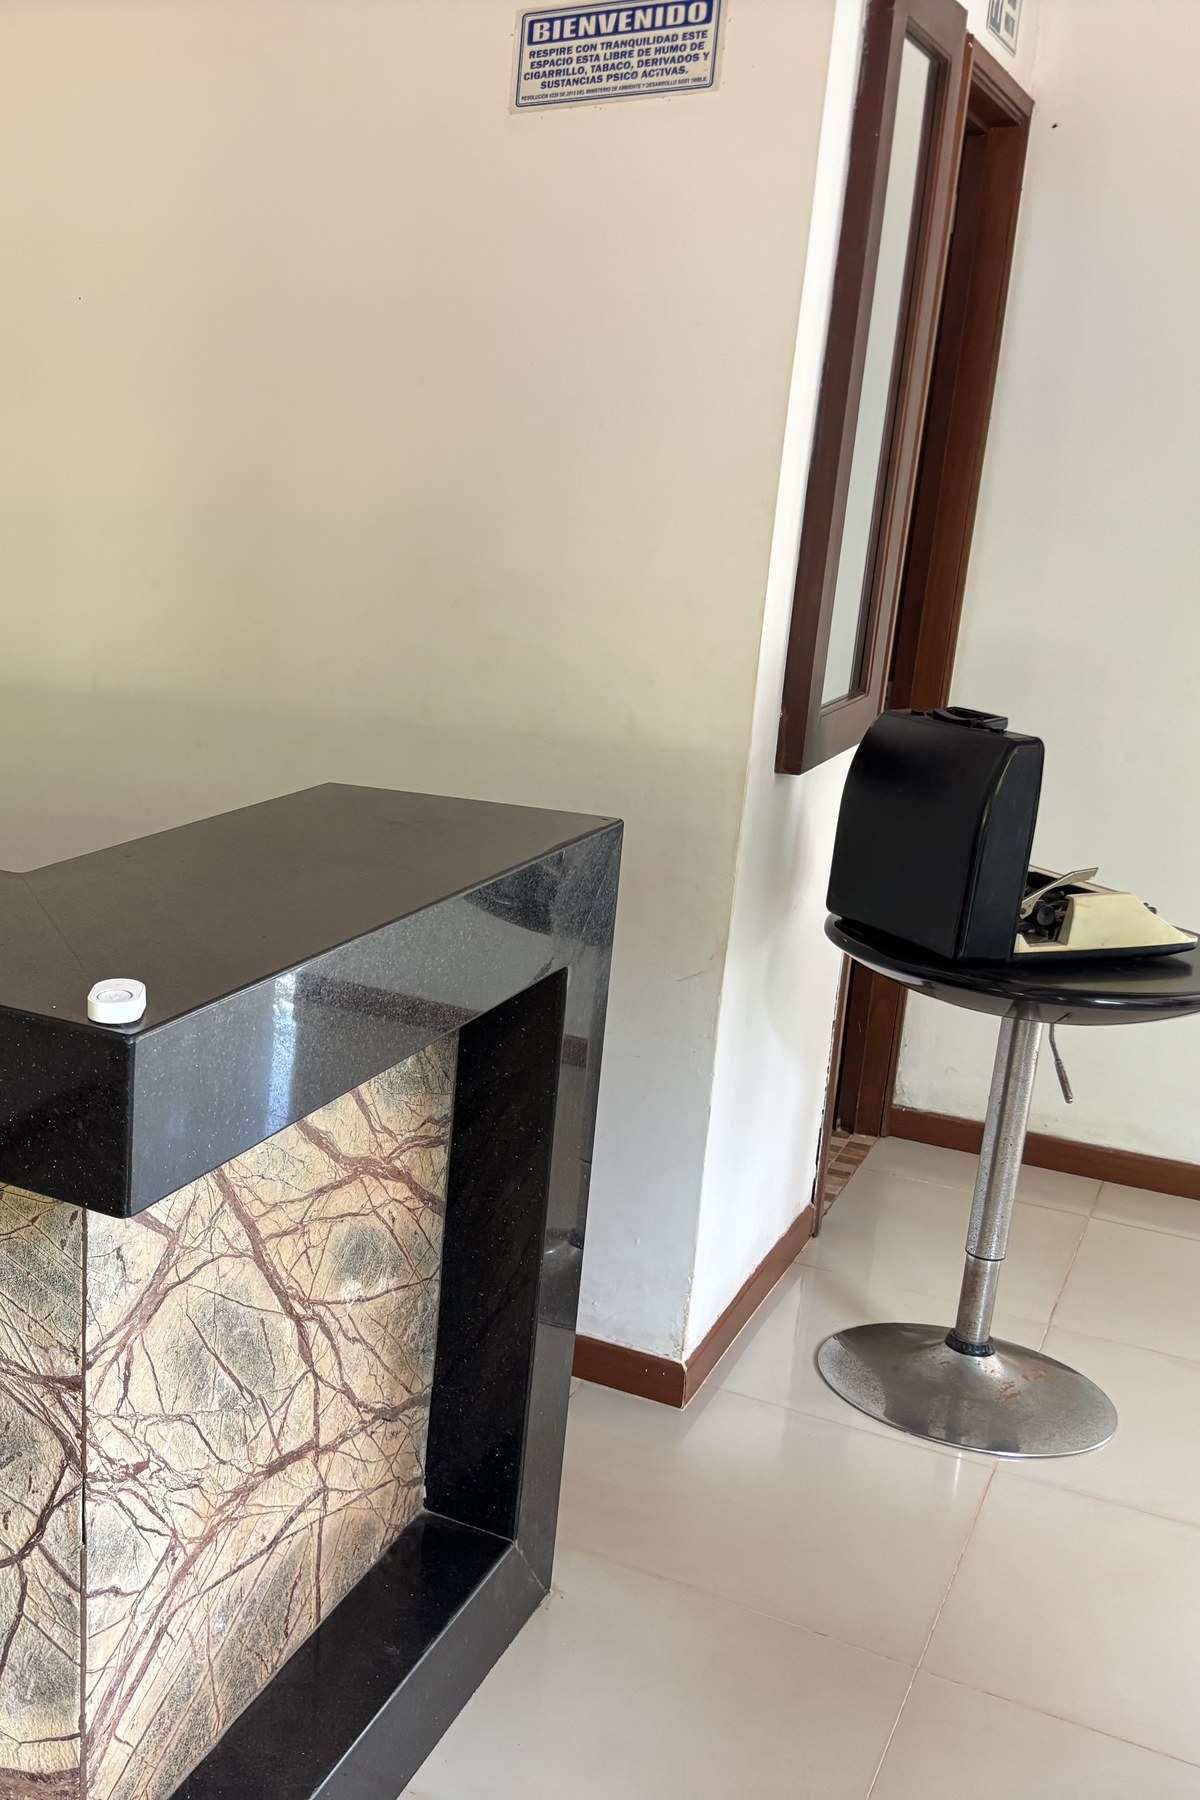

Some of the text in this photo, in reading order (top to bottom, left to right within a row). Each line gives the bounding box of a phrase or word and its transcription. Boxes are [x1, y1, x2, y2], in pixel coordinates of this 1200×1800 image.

[532, 2, 707, 42] BIENVENIDO
[529, 30, 708, 59] RESPIRE CON TRANQUILIDAD ESTE
[530, 41, 704, 70] ESPACIO ESTA LIBRE DE HUMO DE
[523, 51, 711, 81] CIGARRILLO, TABACO, DERIVADOS Y
[540, 65, 689, 90] SUSTANCIAS PSICO ACTIVAS.
